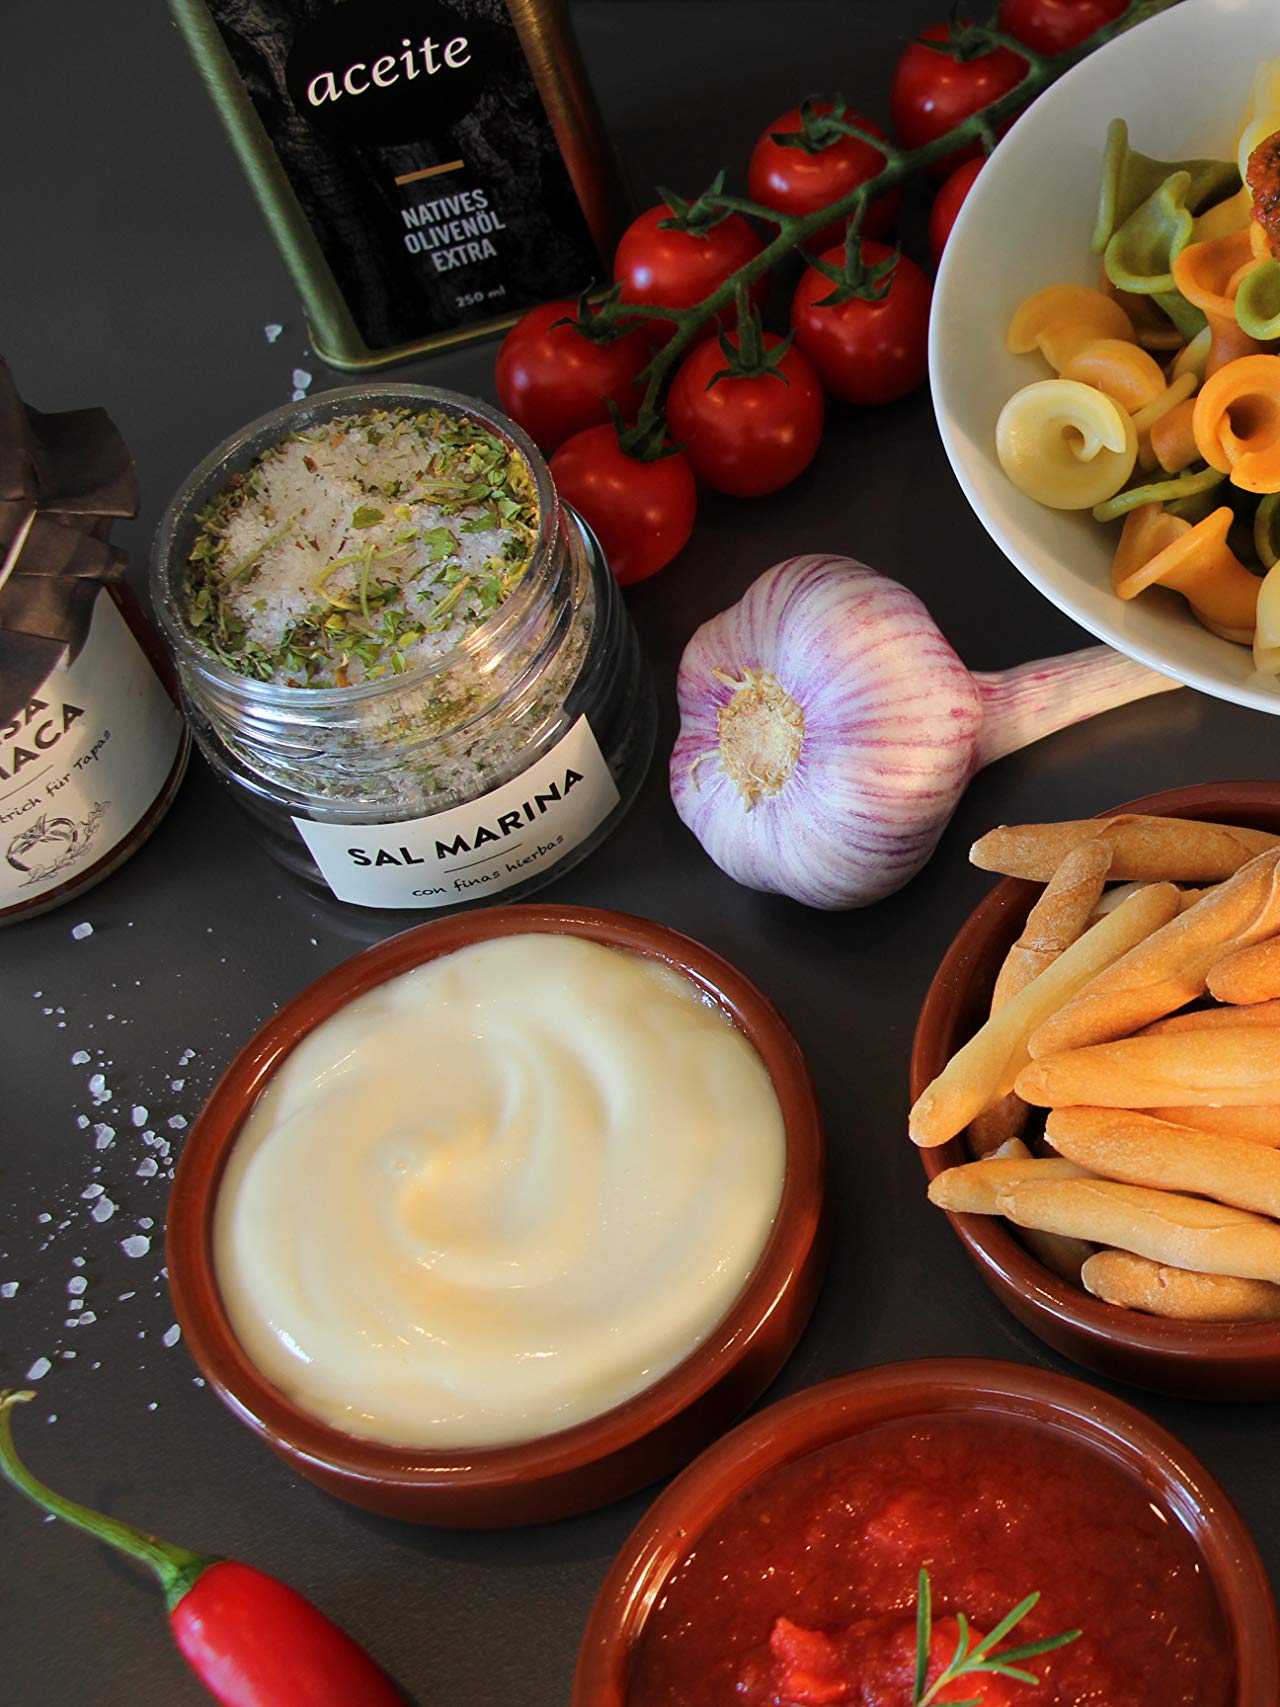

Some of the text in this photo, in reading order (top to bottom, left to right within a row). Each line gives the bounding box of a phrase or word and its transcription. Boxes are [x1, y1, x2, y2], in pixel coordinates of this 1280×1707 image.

[306, 34, 471, 107] aceite
[401, 188, 489, 229] NATIVES
[404, 210, 507, 254] OLIVENÖL
[431, 238, 498, 272] EXTRA
[456, 284, 506, 308] 250 ml
[45, 772, 71, 797] für
[73, 729, 111, 770] Tapas
[347, 768, 585, 868] SAL MARINA
[412, 834, 565, 898] con finas hierbas
